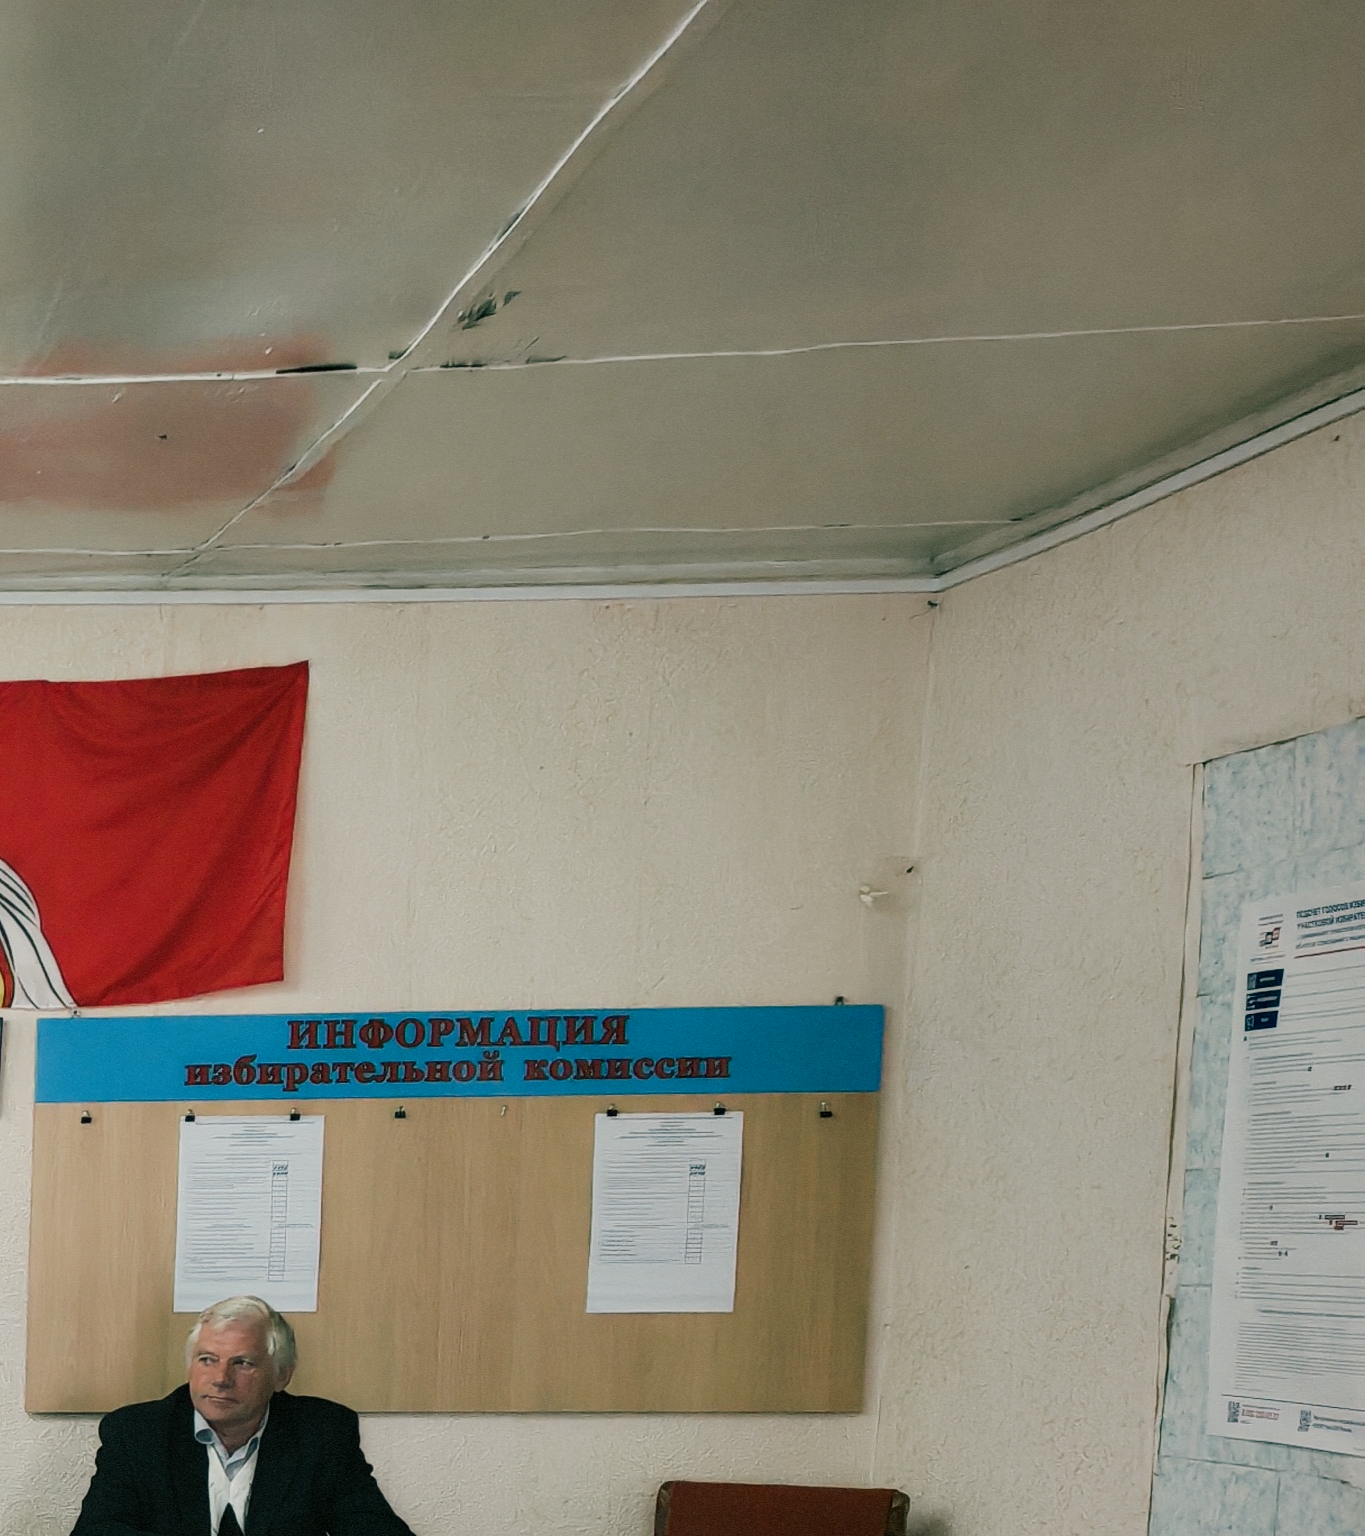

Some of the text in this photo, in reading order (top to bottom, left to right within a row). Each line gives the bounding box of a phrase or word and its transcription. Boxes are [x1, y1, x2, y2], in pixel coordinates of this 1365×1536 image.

[286, 1014, 631, 1051] ИНФОРМАЦИЯ
[183, 1050, 732, 1092] избирательной комиссии
